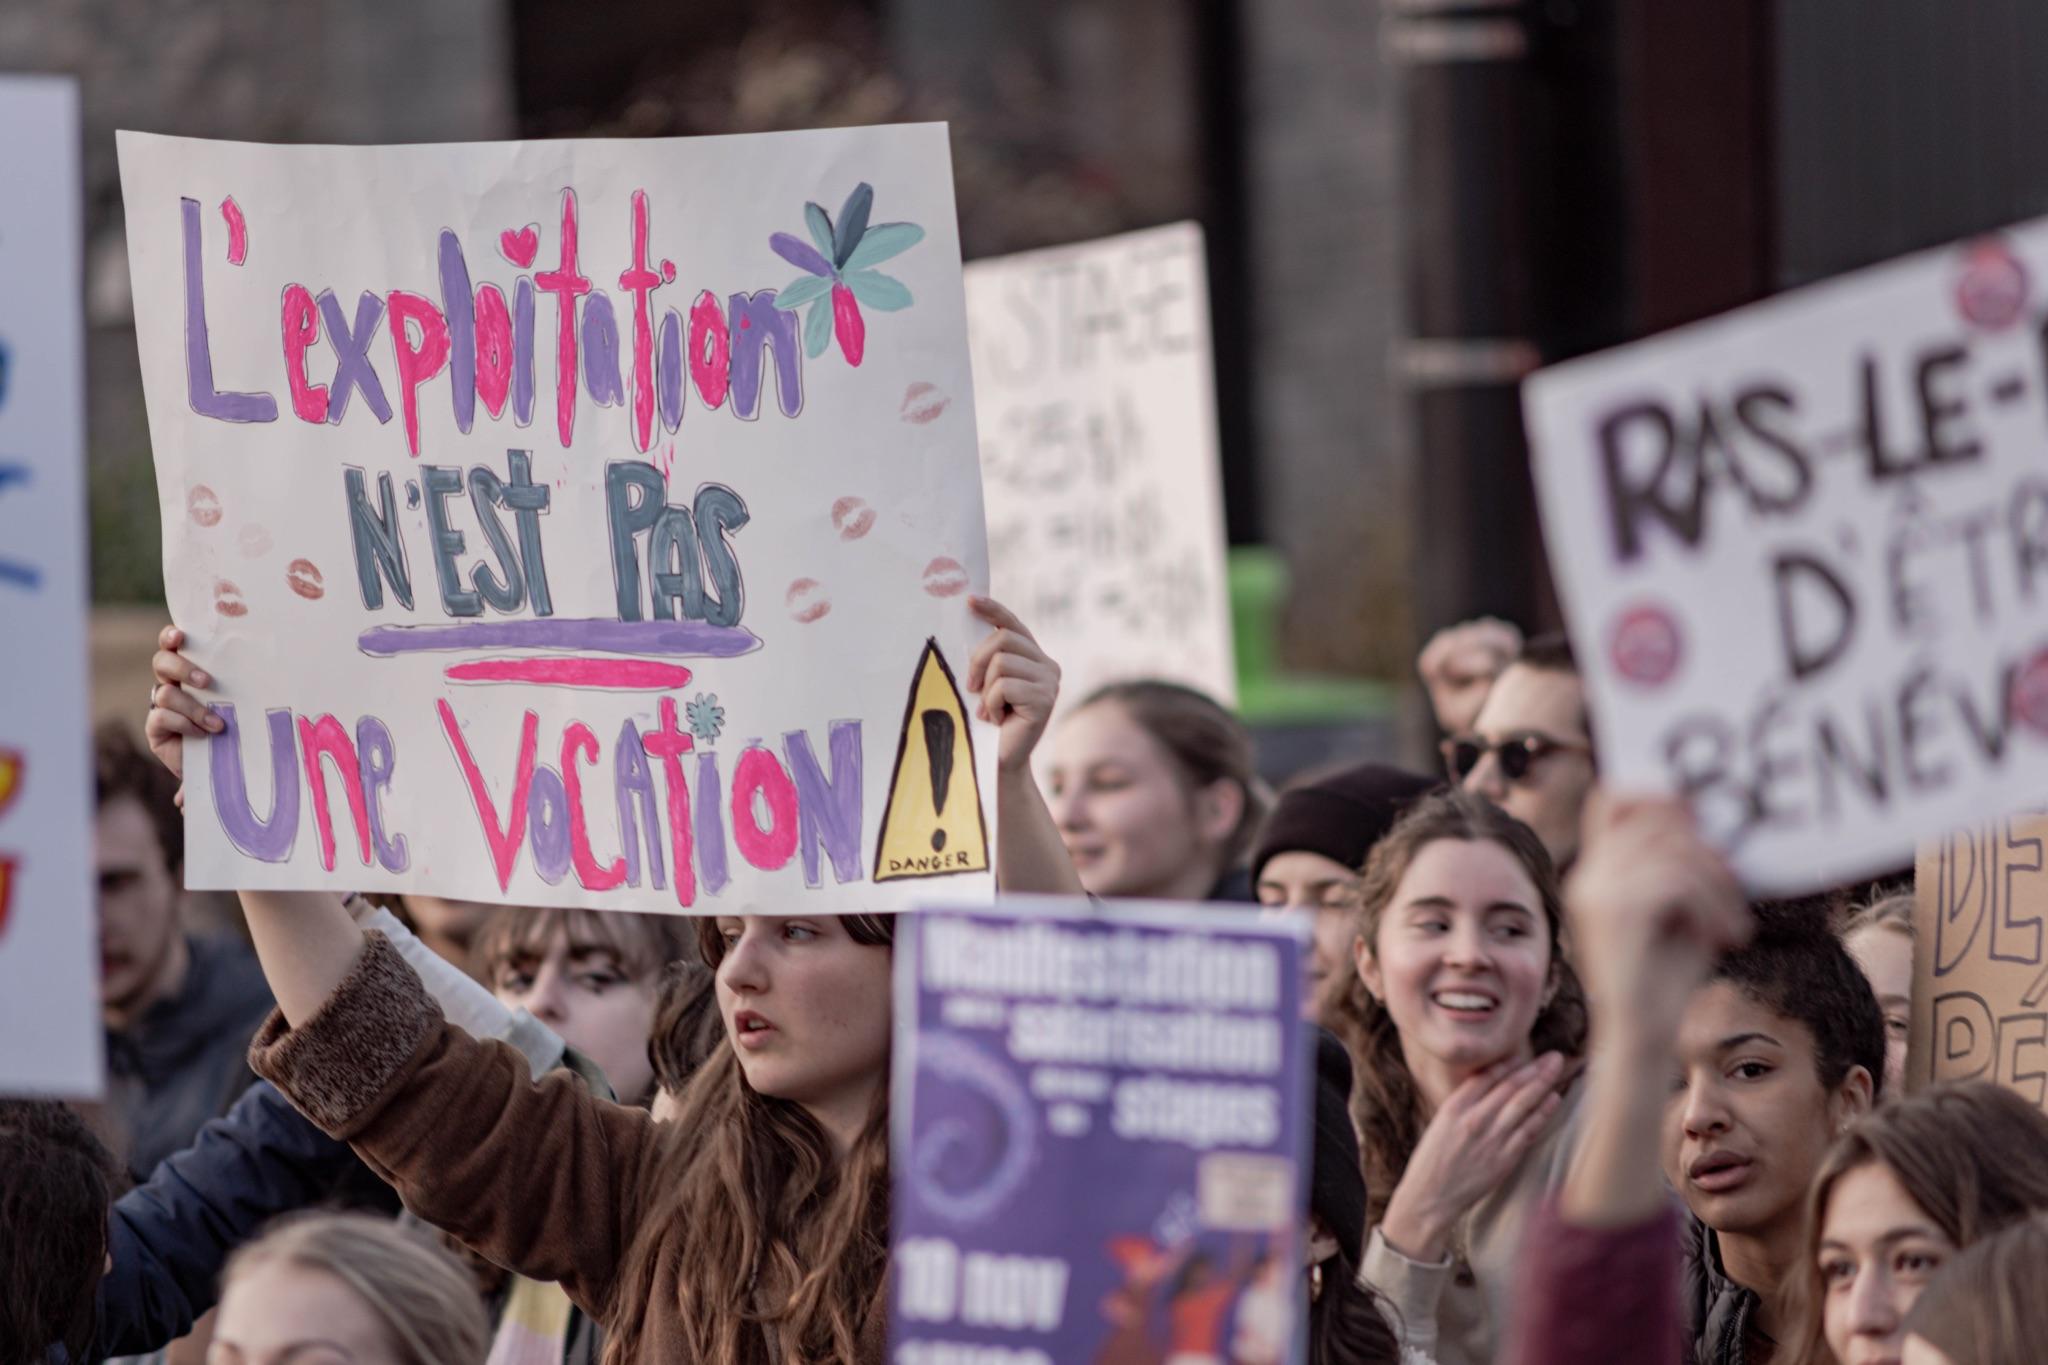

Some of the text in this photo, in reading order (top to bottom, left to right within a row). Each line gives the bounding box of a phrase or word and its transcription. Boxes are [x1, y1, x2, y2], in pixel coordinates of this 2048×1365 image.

[181, 187, 804, 457] L'exploitation
[604, 459, 752, 627] PAS
[1596, 312, 2048, 565] RAS-LE-
[888, 850, 970, 872] DANGER
